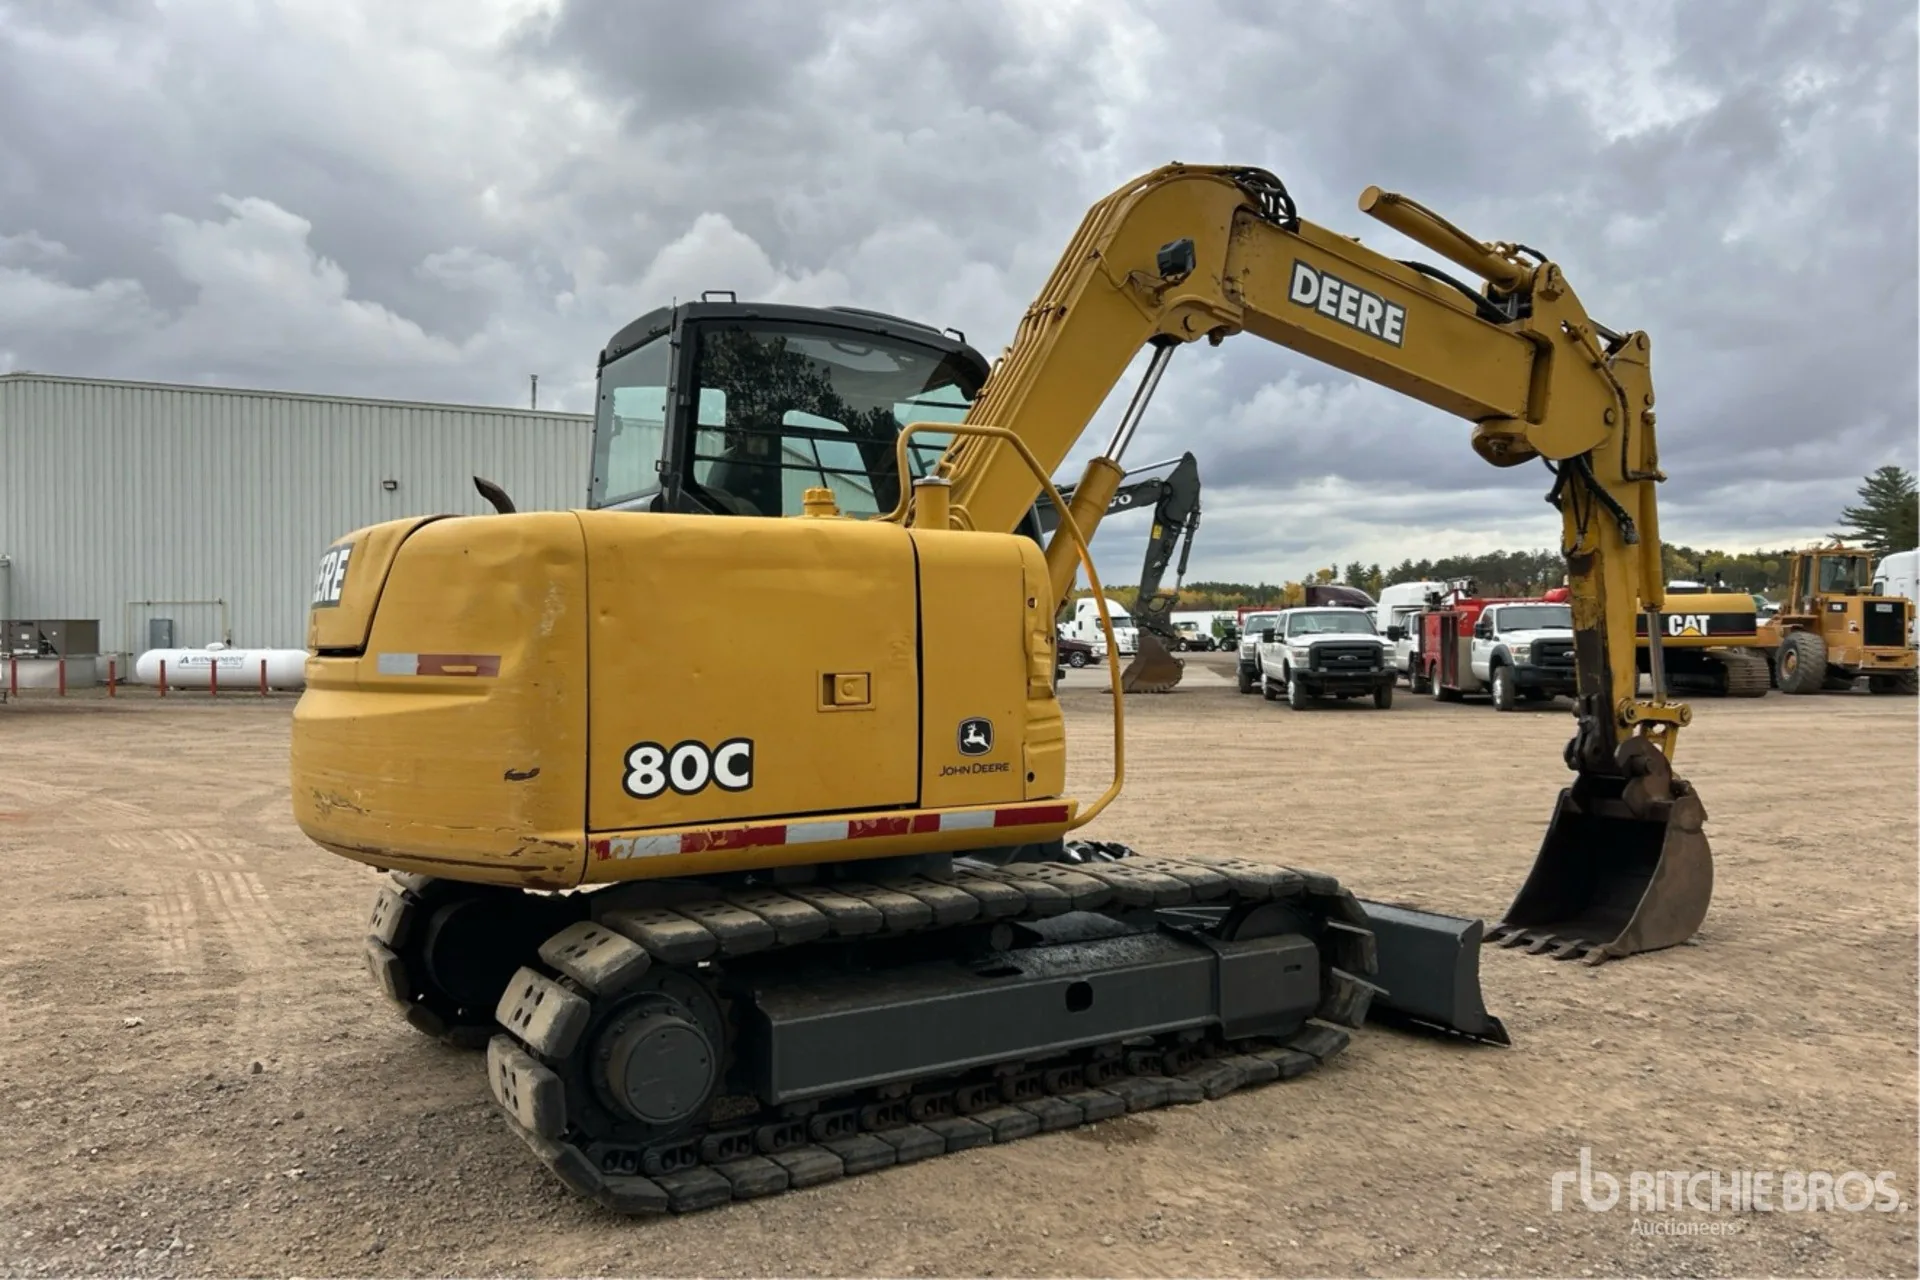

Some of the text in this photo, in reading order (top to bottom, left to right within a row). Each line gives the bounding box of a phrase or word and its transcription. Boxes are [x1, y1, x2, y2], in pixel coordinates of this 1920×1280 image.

[1290, 262, 1405, 345] DEERE
[1668, 614, 1711, 637] CAT
[625, 740, 751, 797] 80C
[938, 762, 1010, 778] JOHN DEERE
